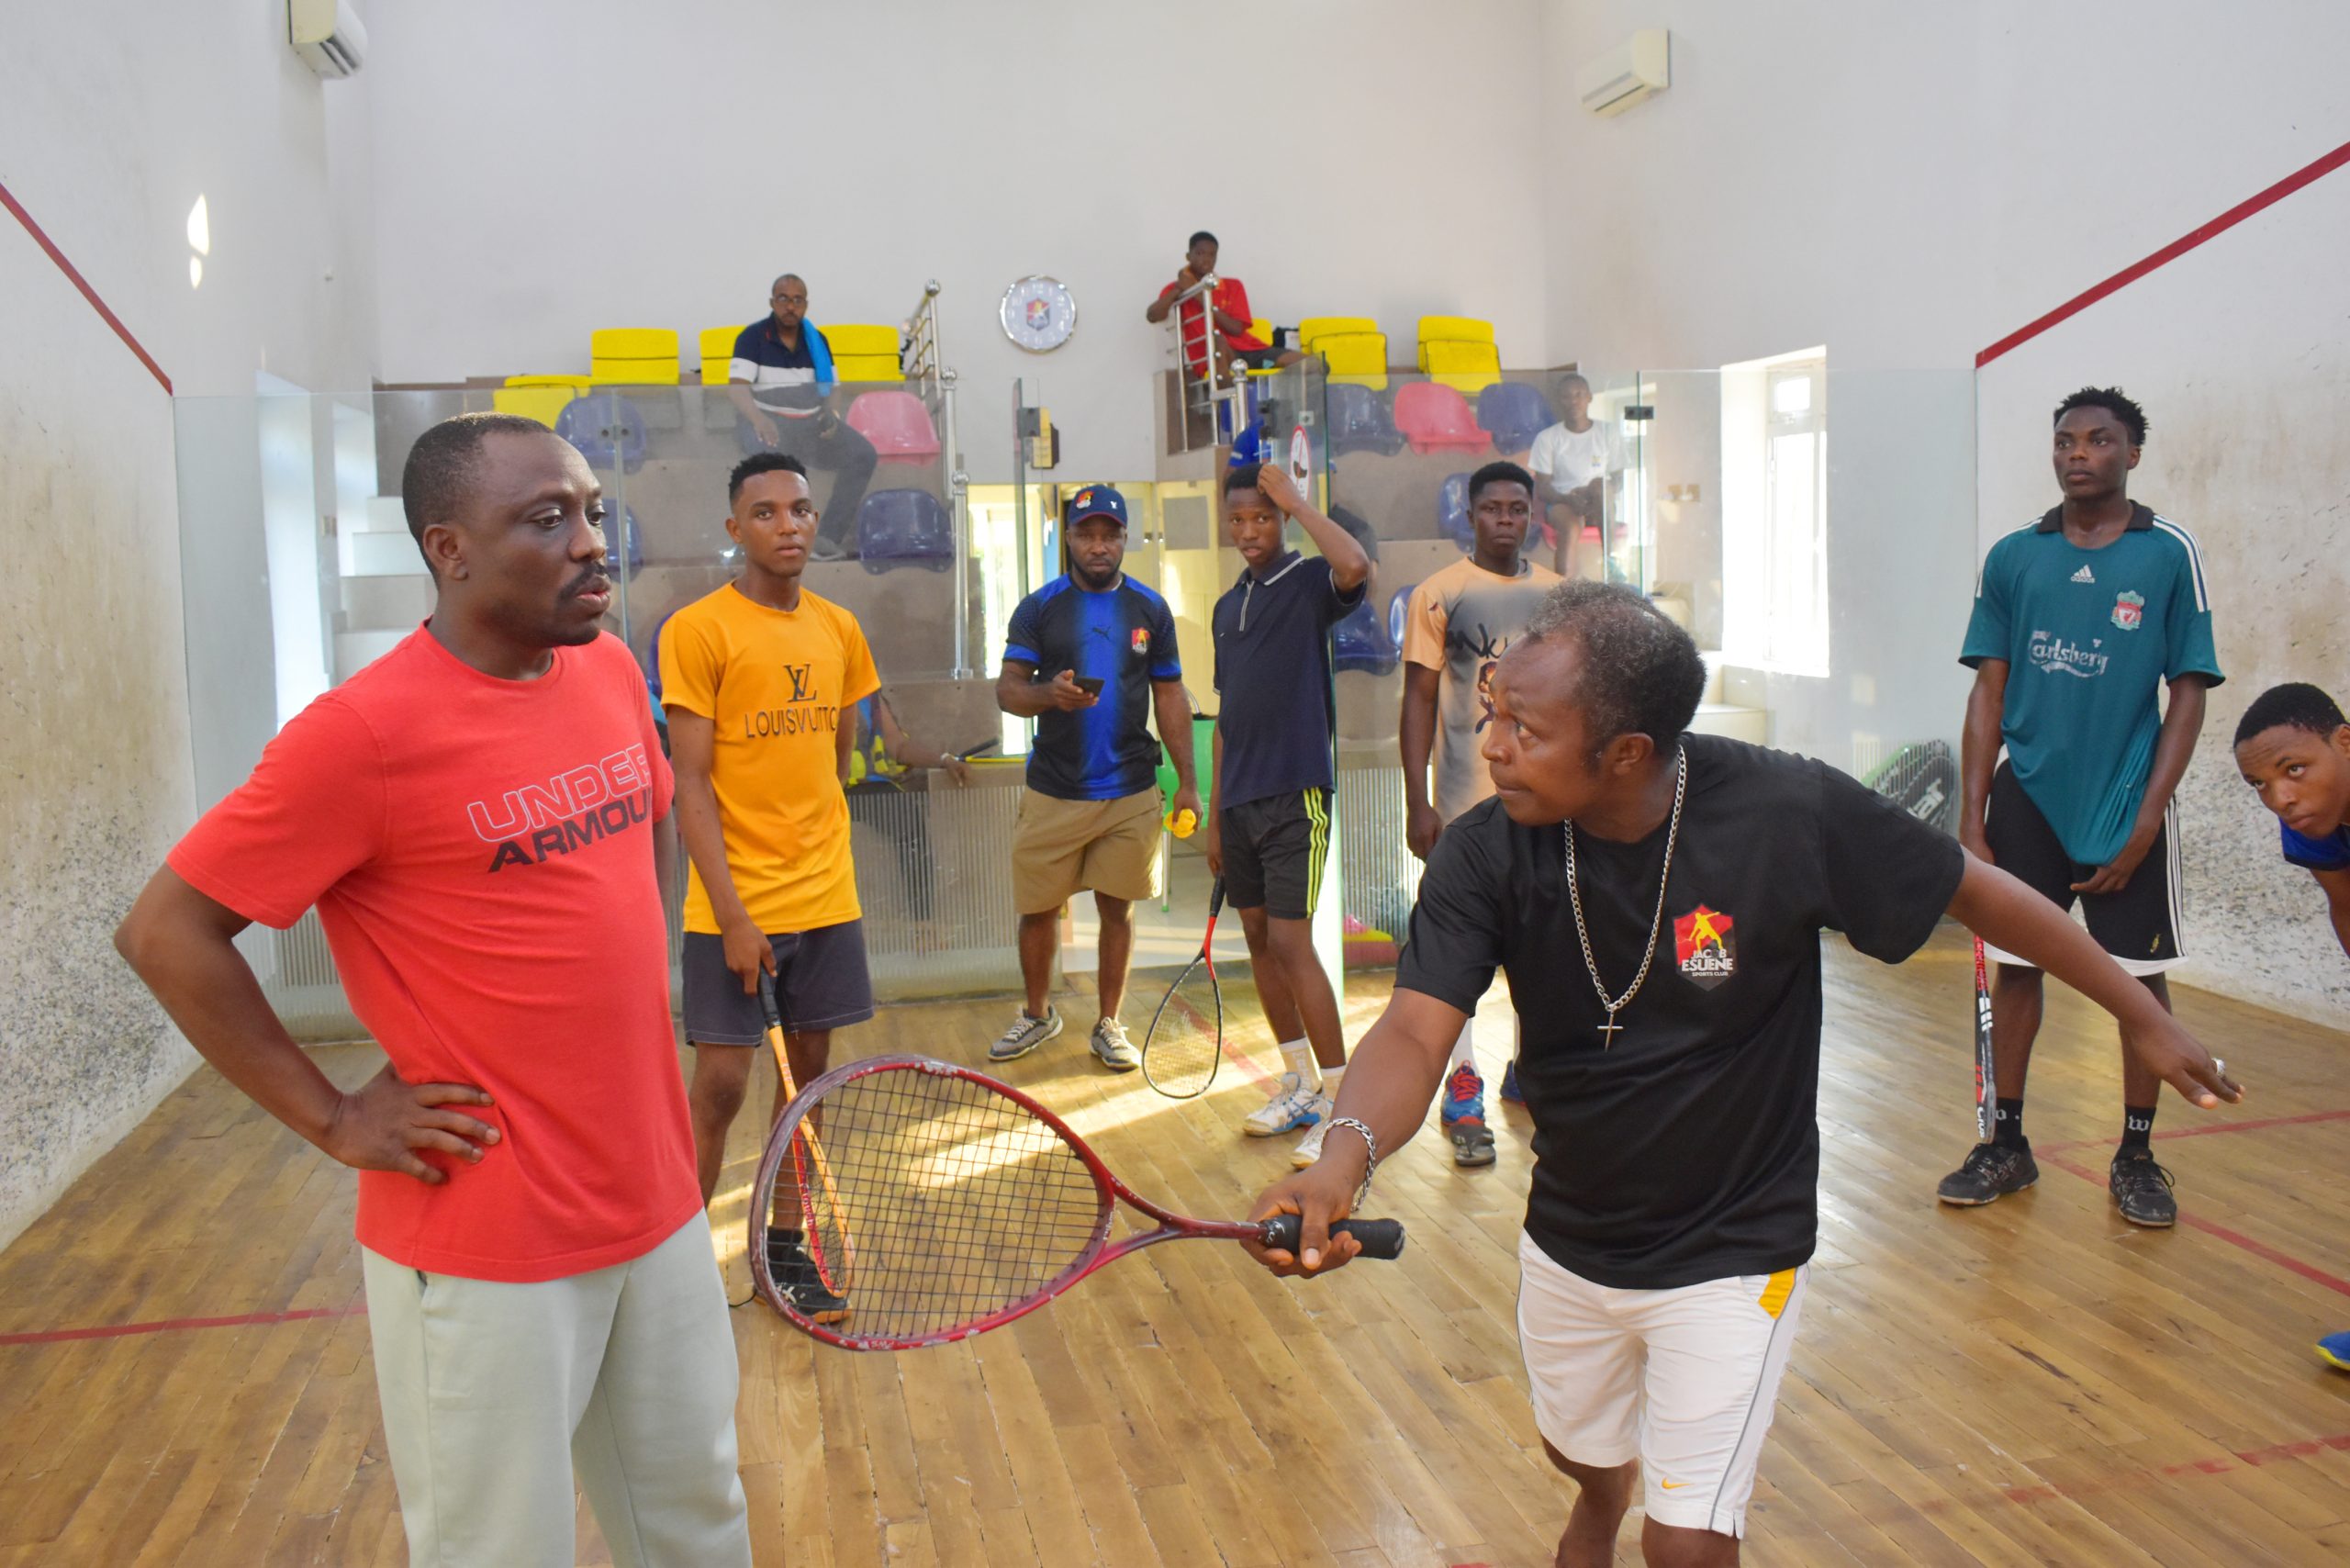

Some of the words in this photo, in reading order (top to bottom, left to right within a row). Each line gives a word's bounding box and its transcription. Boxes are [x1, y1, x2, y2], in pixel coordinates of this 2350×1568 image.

[2029, 631, 2109, 678] Carlsberg
[467, 743, 651, 843] UNDER
[487, 786, 653, 873] ARMOU
[1681, 958, 1734, 971] ESUENE
[1691, 948, 1727, 958] JACOB
